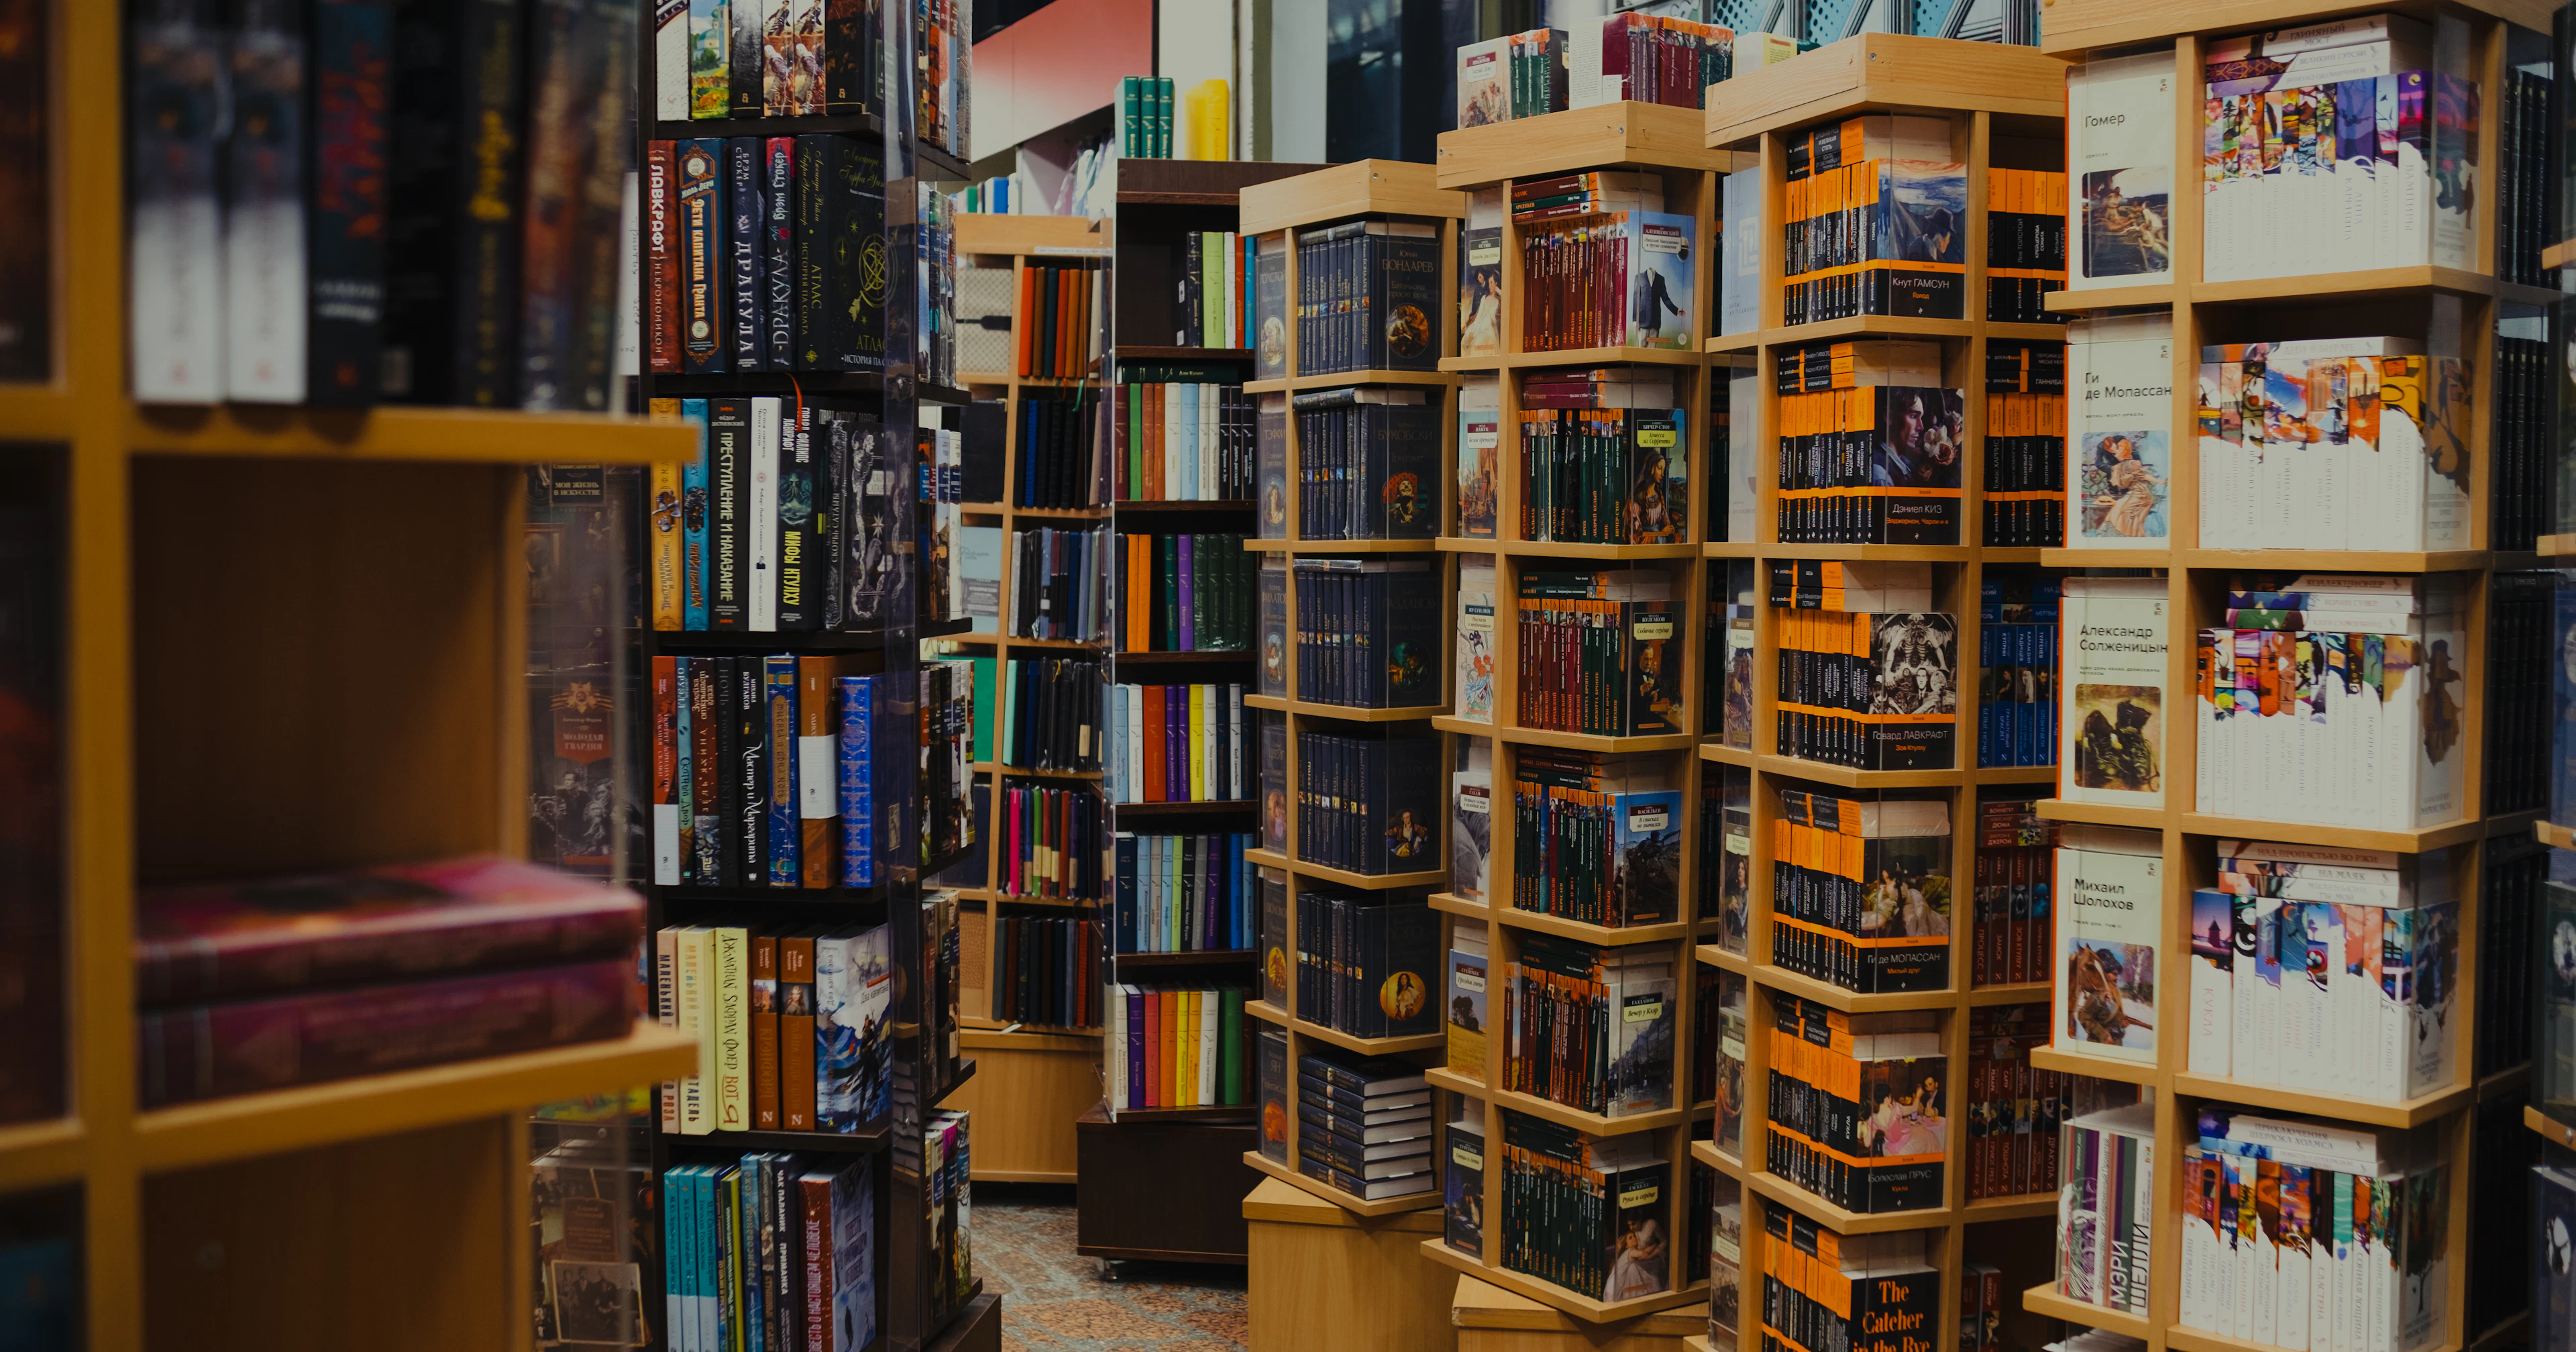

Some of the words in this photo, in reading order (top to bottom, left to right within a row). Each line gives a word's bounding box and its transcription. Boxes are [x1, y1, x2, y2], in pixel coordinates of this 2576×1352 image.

[2290, 22, 2345, 40] ГЛИНЯНЫЙ
[2304, 36, 2331, 46] МОСТ
[2300, 53, 2336, 65] ВЕЛИКИЙ
[2085, 114, 2125, 128] Гомер
[651, 164, 664, 253] ЛАВКРАФТ
[1645, 228, 1680, 237] АЛЕШКОВСКИЙ
[692, 229, 706, 281] КАПИТАНА
[1382, 259, 1434, 272] БОНДАРЕВ
[811, 264, 822, 309] АТЛАС
[1892, 277, 1913, 289] Кнут
[1913, 277, 1949, 289] ГАМСУН
[734, 242, 753, 353] ДРАКУЛА
[771, 254, 789, 346] ДРАКУЛА
[801, 290, 808, 304] ПА
[1912, 291, 1930, 300] Голод
[655, 263, 663, 353] НЕКРОНОМИКОН
[844, 353, 872, 366] ИСТОРИЯ
[2085, 372, 2099, 384] Ги
[2086, 390, 2100, 401] де
[2105, 386, 2171, 398] Мопассан
[782, 417, 794, 452] ЛАВКРАФТ
[1992, 439, 2000, 468] ХАРРИС
[720, 432, 733, 520] ПРЕСТУПЛЕНИЕ
[1992, 469, 2000, 490] Томас
[832, 492, 840, 528] САТАНЫ
[1892, 503, 1923, 515] Дэниел
[1924, 503, 1943, 514] КИЗ
[720, 523, 733, 532] И
[784, 531, 802, 564] МИФЫ
[831, 530, 840, 563] СКОРБЬ
[720, 535, 733, 601] НАКАЗАНИЕ
[782, 568, 800, 605] КТУЛХУ
[2306, 579, 2385, 588] КОЛЛЕКЦИОНЕР
[2080, 624, 2153, 639] Александр
[2080, 639, 2168, 654] Солженицын
[677, 667, 685, 709] ОРУЭЛЛ
[719, 669, 729, 706] НОЧЬ
[1872, 730, 1902, 741] Говард
[1903, 730, 1949, 740] ЛАВКРАФТ
[1907, 744, 1927, 752] Ктулху
[743, 741, 763, 790] Мастер
[743, 797, 763, 864] Маргарита
[2257, 848, 2277, 857] НАД
[2279, 849, 2339, 860] ПРОПАСТЬЮ
[2341, 853, 2353, 862] ВО
[2355, 854, 2379, 864] РЖИ
[2075, 878, 2125, 894] Михаил
[2337, 870, 2367, 880] МАЯК
[2074, 893, 2134, 910] Шолохов
[1867, 955, 1876, 964] Ги
[1878, 955, 1888, 965] де
[1890, 952, 1941, 964] МОПАССАН
[685, 945, 699, 1010] МАЛЕНЬКИЙ
[1458, 976, 1472, 985] Гроздья
[1461, 968, 1480, 976] СТЕЙНБЕК
[1887, 967, 1905, 975] Милый
[1906, 967, 1921, 976] друг
[659, 955, 675, 1017] МАЛЕНЬКИЙ
[2204, 988, 2214, 1037] КУКЛА
[790, 1021, 801, 1052] ТАЙНА
[723, 1039, 739, 1070] ФОЕР
[759, 1029, 773, 1099] КРЭНФОРД
[724, 1076, 739, 1100] ВОТ
[663, 1096, 675, 1121] РОЗА
[1868, 1172, 1907, 1183] Болеслав
[1909, 1169, 1932, 1180] ПРУС
[1640, 1192, 1656, 1200] сердце
[777, 1190, 786, 1233] ПАЛАНИК
[806, 1220, 820, 1261] ЧЕЛОВЕКЕ
[780, 1243, 788, 1295] ПРИМАНКА
[2108, 1239, 2129, 1305] МЭРИ
[2130, 1223, 2149, 1308] ШЕЛЛИ
[807, 1263, 821, 1314] НАСТОЯЩЕМ
[1878, 1280, 1910, 1304] The
[1862, 1308, 1924, 1334] Catcher
